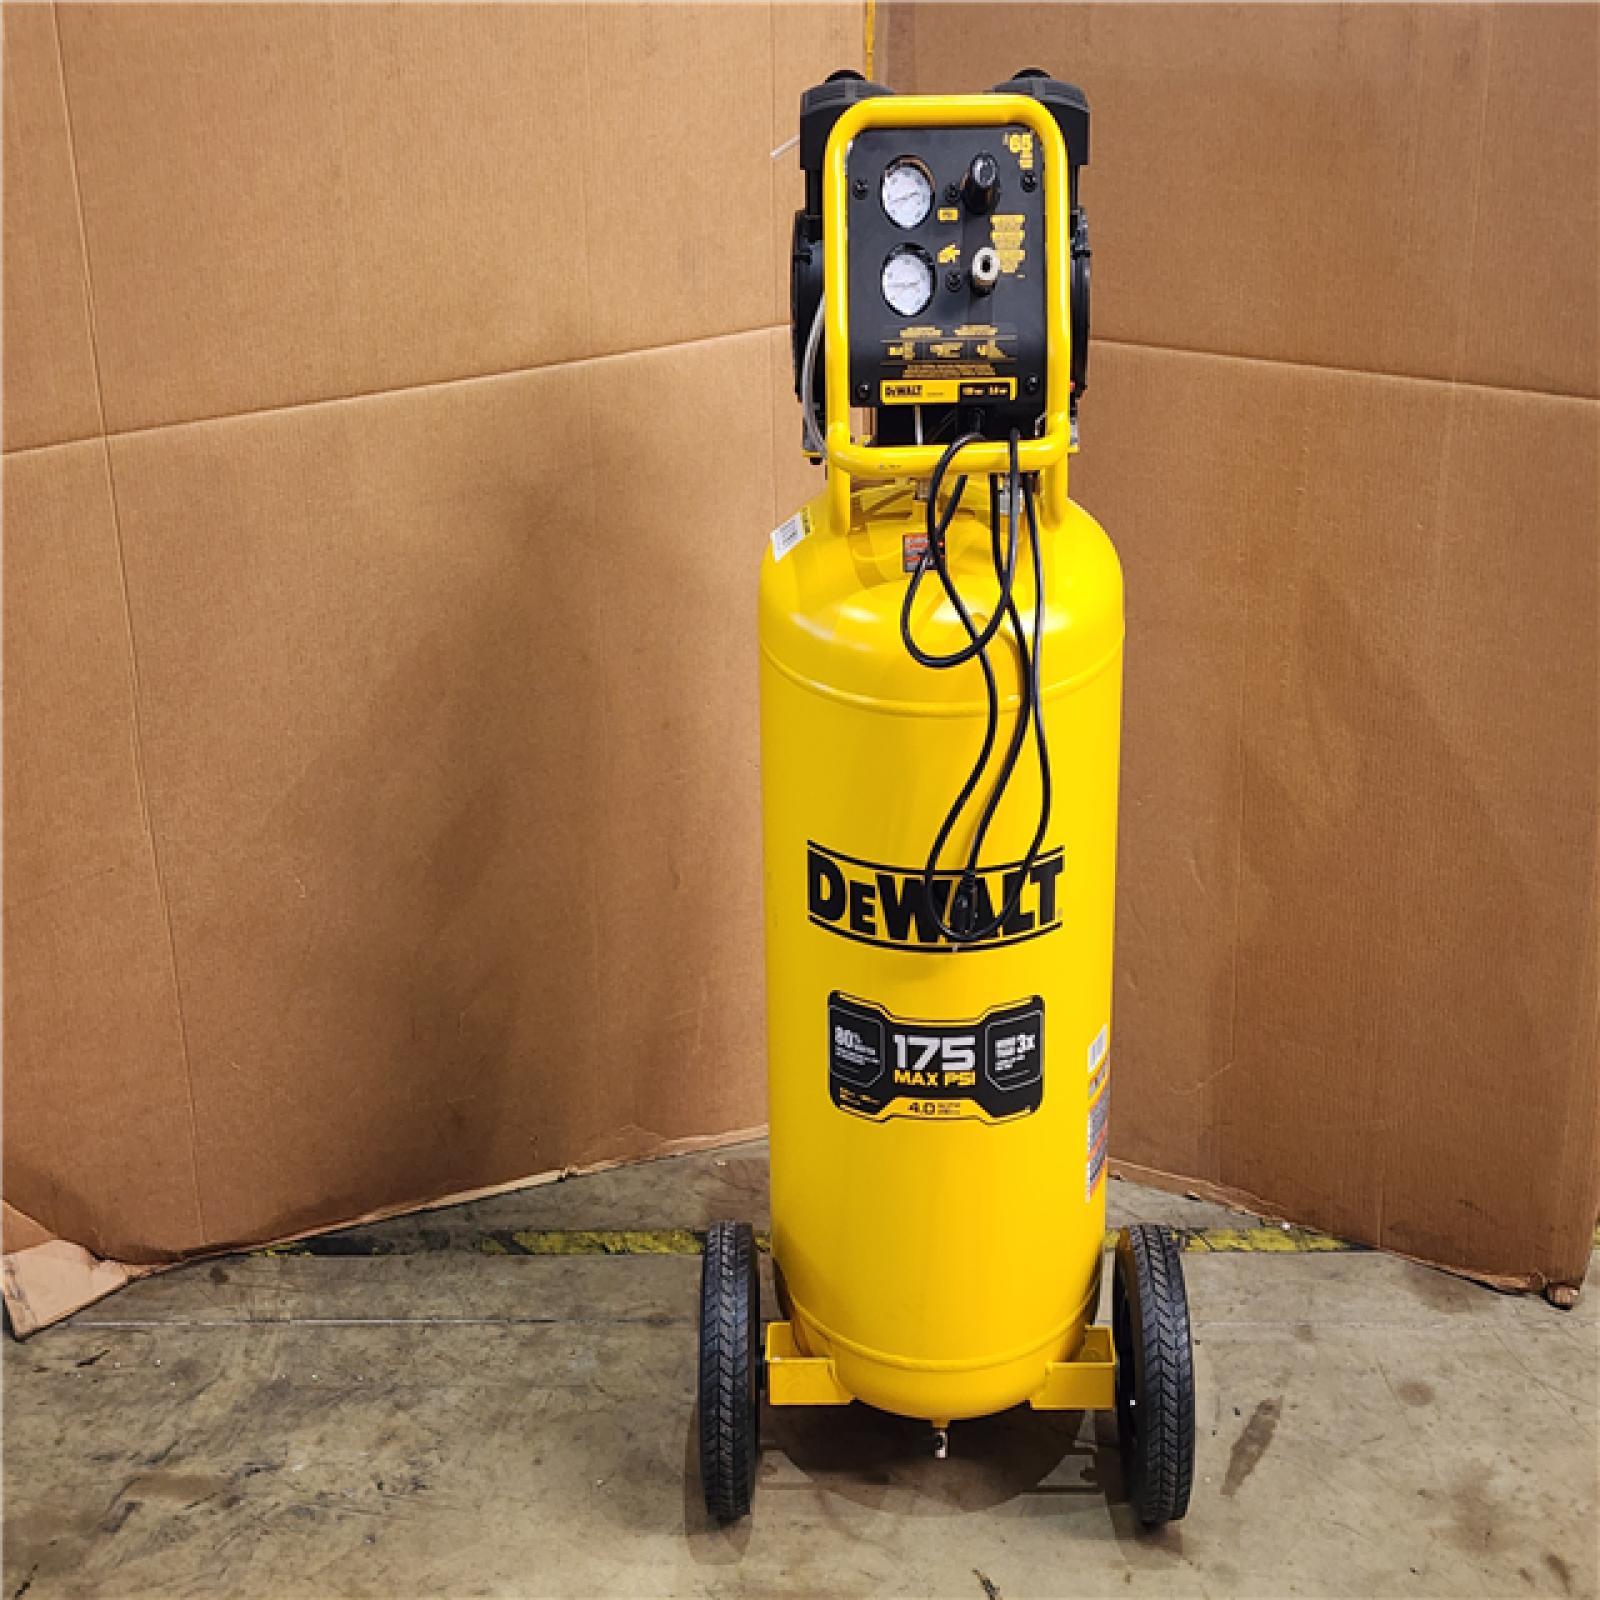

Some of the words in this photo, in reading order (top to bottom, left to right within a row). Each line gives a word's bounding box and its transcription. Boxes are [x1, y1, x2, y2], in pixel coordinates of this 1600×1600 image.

[892, 1034, 977, 1071] 175
[894, 1070, 939, 1087] MAX
[944, 1070, 976, 1087] PSI
